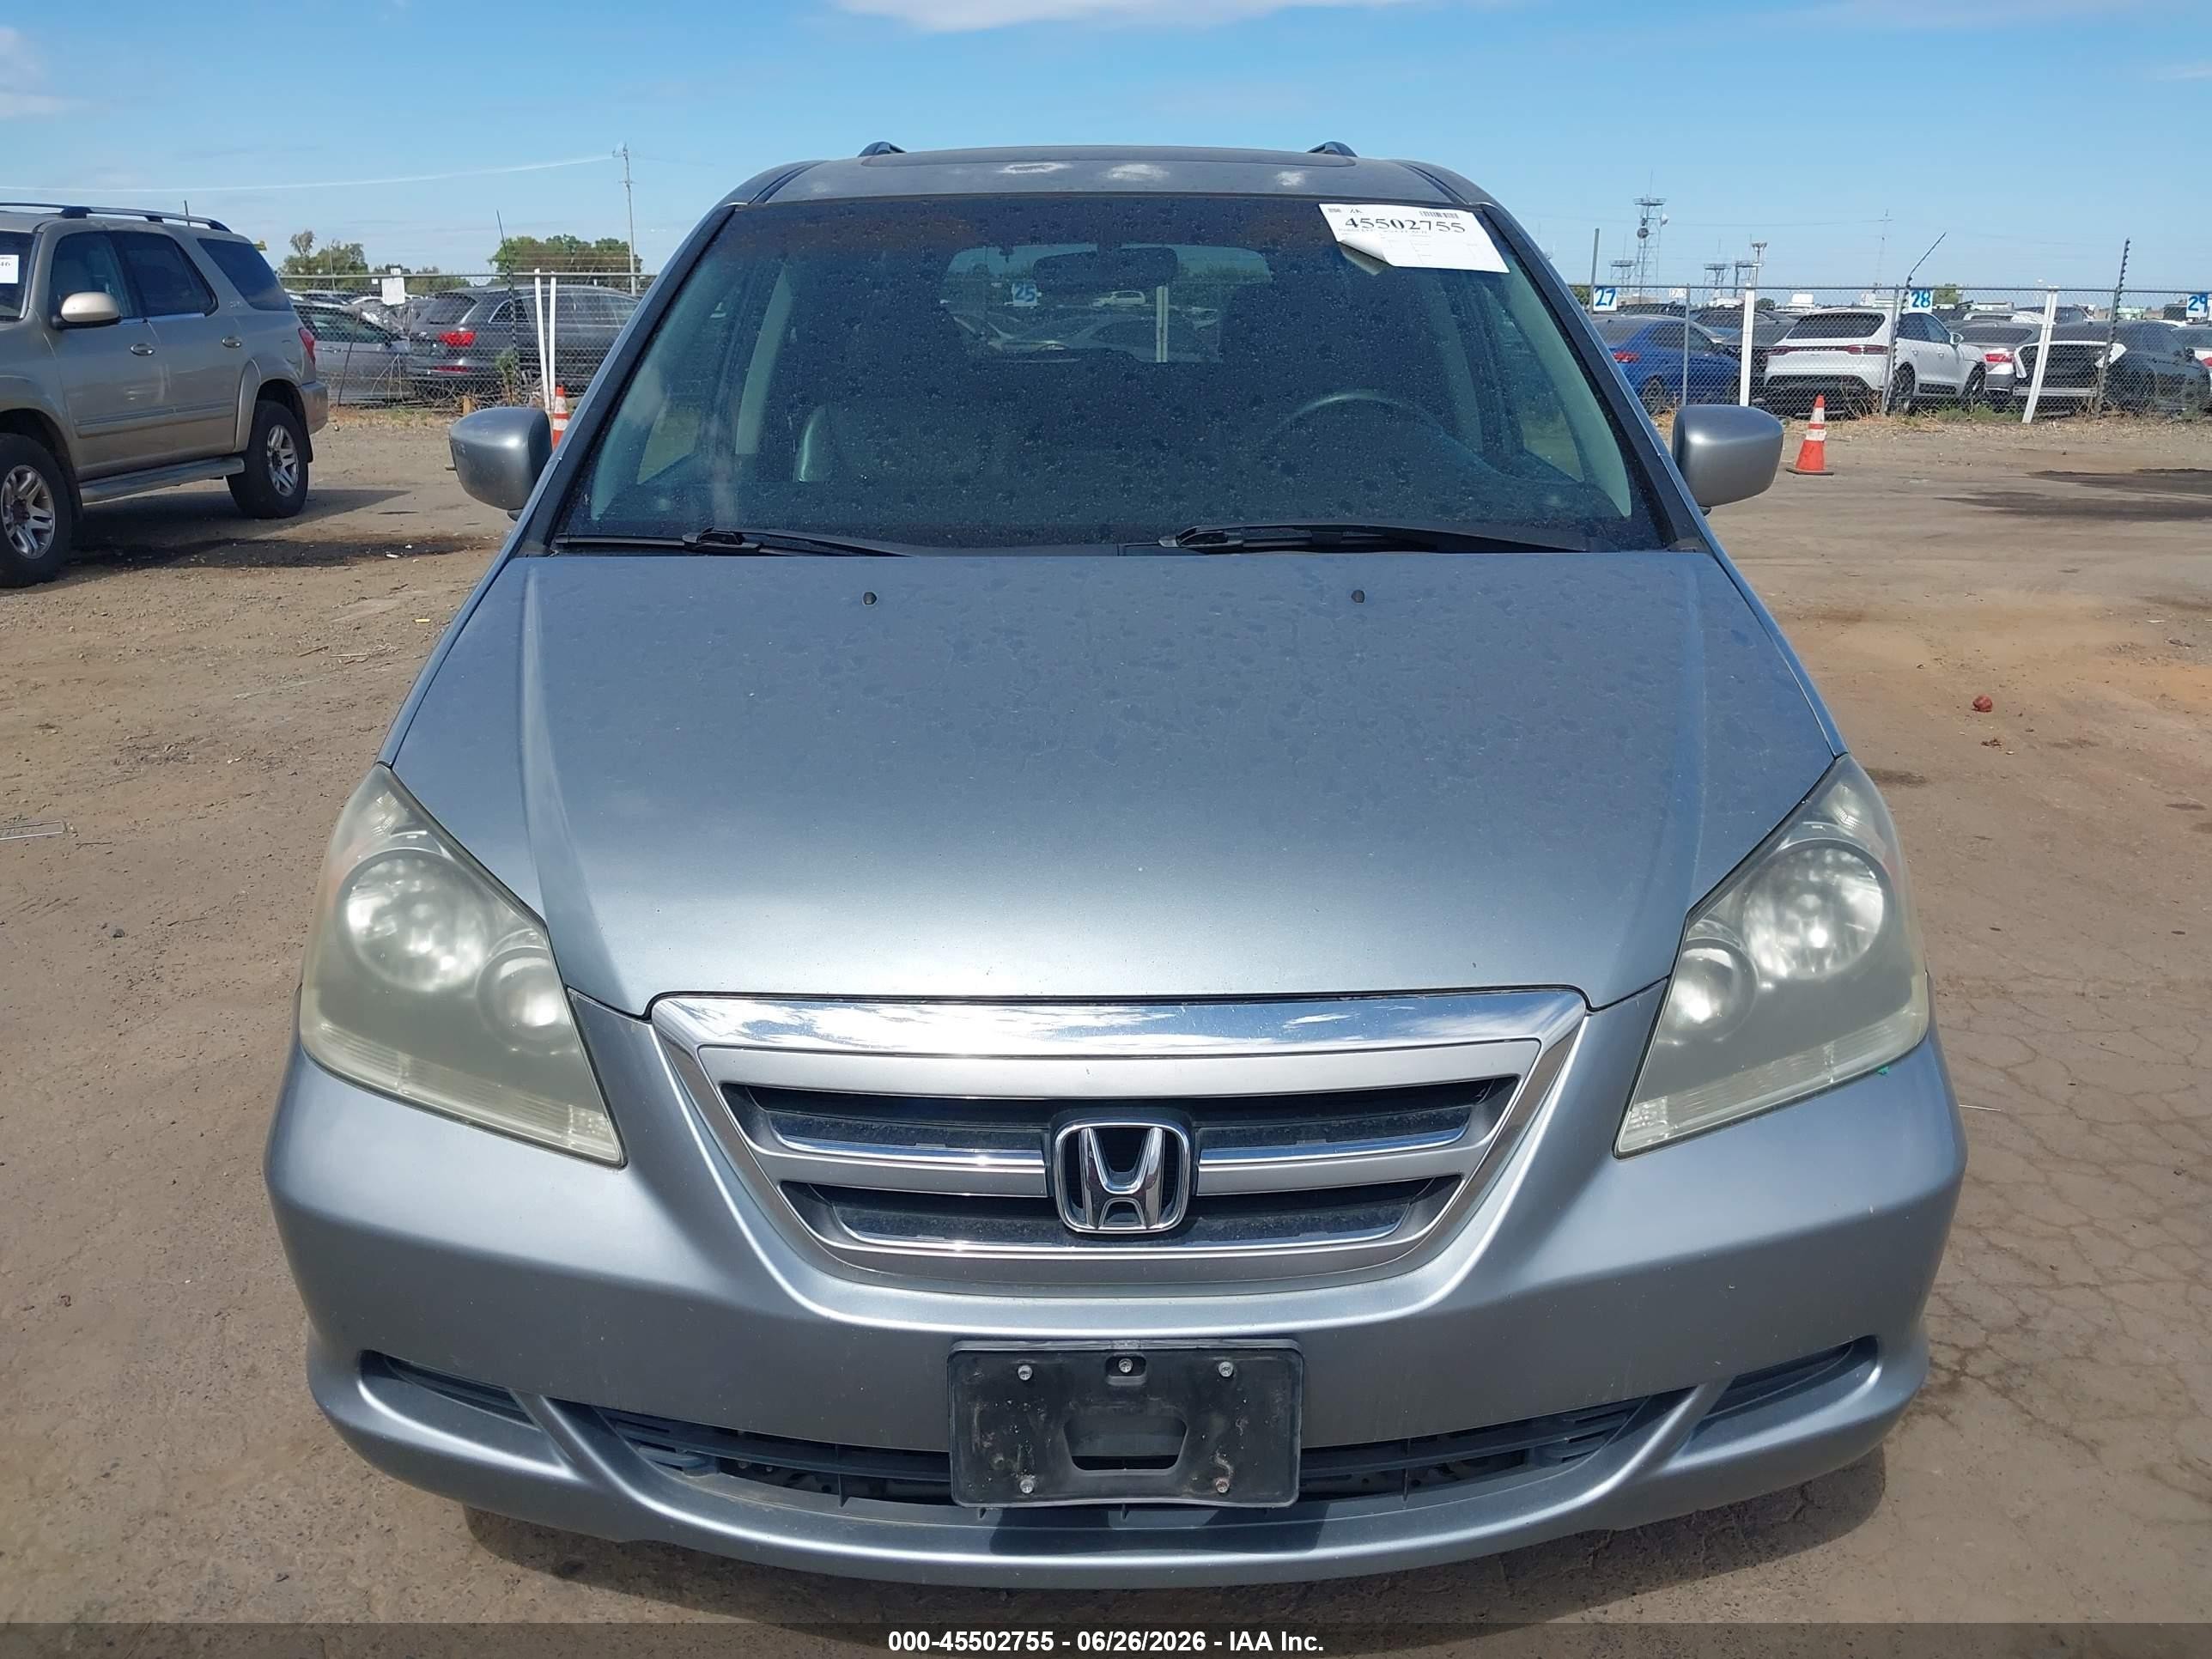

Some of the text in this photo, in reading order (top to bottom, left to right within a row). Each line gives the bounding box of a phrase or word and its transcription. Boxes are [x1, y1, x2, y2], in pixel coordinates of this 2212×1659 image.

[1345, 217, 1465, 233] 45502755
[1014, 283, 1036, 302] 25
[1595, 286, 1616, 307] 27
[1911, 289, 1931, 308] 28
[2188, 293, 2208, 313] 29
